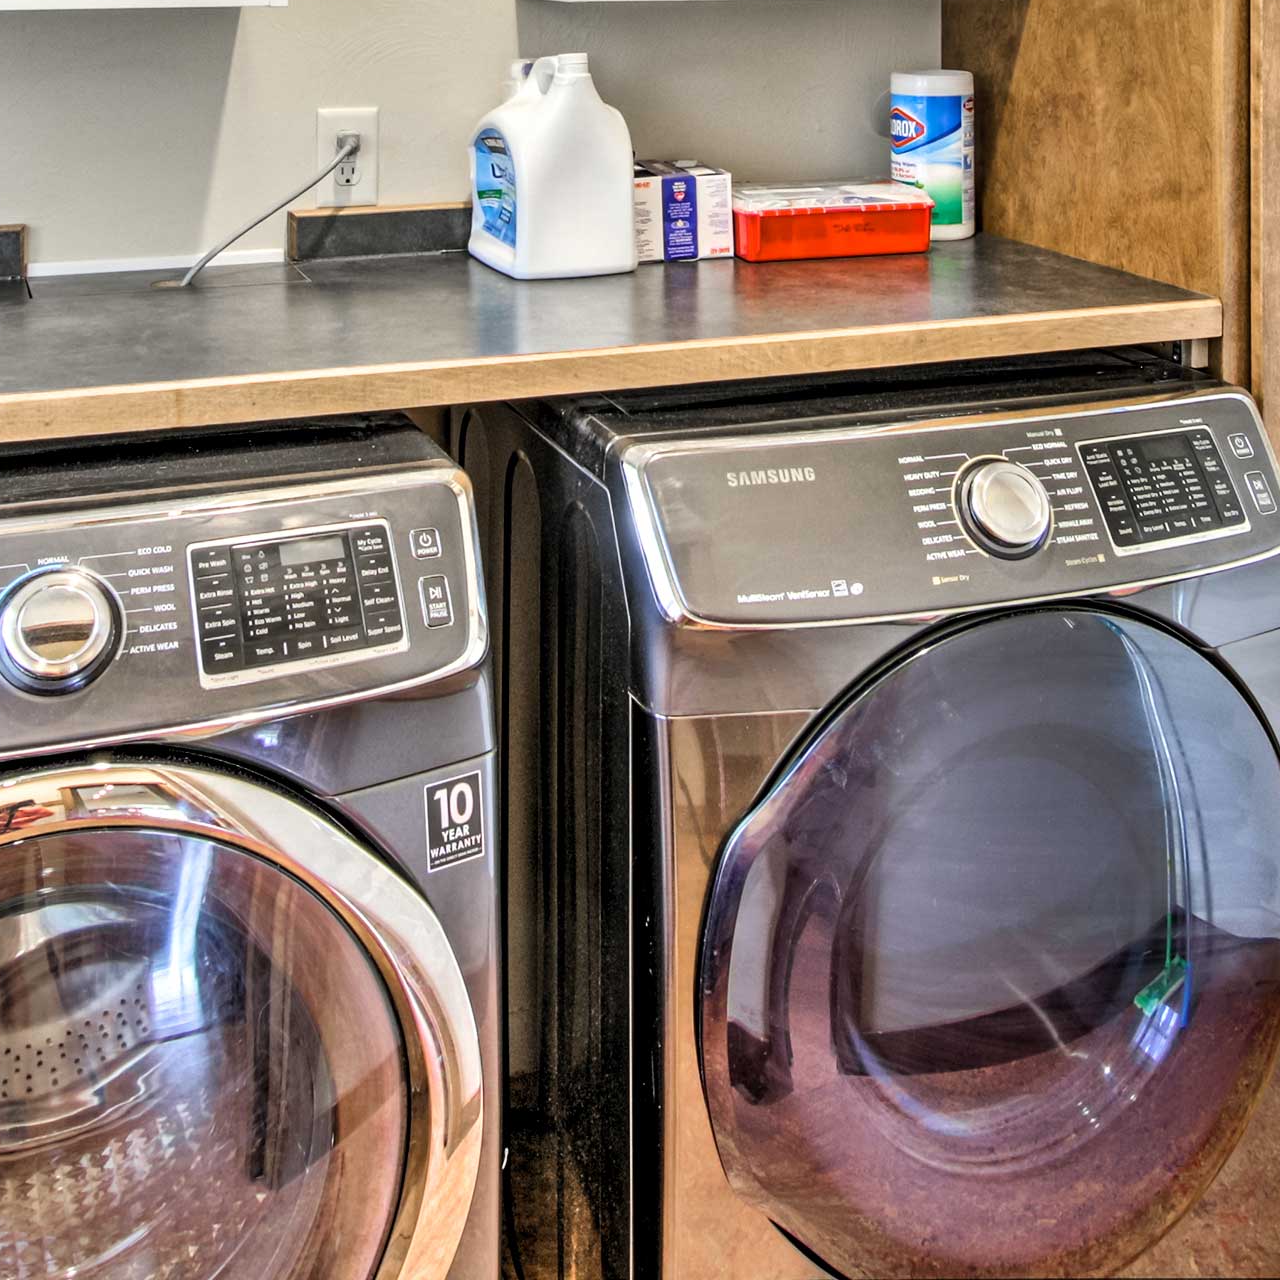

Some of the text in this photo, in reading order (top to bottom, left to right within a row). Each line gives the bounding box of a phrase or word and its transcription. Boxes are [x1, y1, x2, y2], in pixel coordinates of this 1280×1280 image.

[1032, 441, 1067, 451] ECO NORMAL
[898, 456, 924, 464] NORMAL
[1044, 458, 1060, 467] QUICK
[726, 467, 816, 487] SAMSUNG
[903, 470, 940, 481] HEAVY DUTY
[1052, 471, 1077, 480] TIME DRY
[908, 487, 935, 497] BEDDING
[1056, 486, 1083, 496] AIR FLUFF
[913, 502, 946, 512] PERM PRESS
[1064, 502, 1089, 511] REFRESH
[917, 520, 937, 529] WOOL
[922, 534, 953, 545] DELICATES
[1056, 535, 1074, 544] STEAM
[153, 546, 172, 554] COLD
[417, 546, 438, 555] POWER
[927, 549, 966, 560] ACTIVE WEAR
[37, 556, 69, 565] NORMAL
[210, 559, 227, 567] Wash
[128, 565, 173, 577] QUICK WASH
[304, 580, 318, 588] High
[130, 584, 175, 595] PERM PRESS
[200, 591, 216, 599] Extra
[290, 592, 304, 600] High
[154, 603, 176, 613] WOOL
[292, 601, 314, 609] Medium
[429, 602, 447, 610] START
[139, 622, 177, 633] DELICATES
[205, 619, 236, 629] Extra Spin
[368, 625, 401, 636] Super Speed
[330, 633, 359, 644] Soil Level
[129, 641, 179, 654] ACTIVE WEAR
[298, 641, 312, 649] Spin
[433, 782, 473, 829] 10
[441, 824, 470, 842] YEAR
[430, 833, 482, 858] WARRANTY
